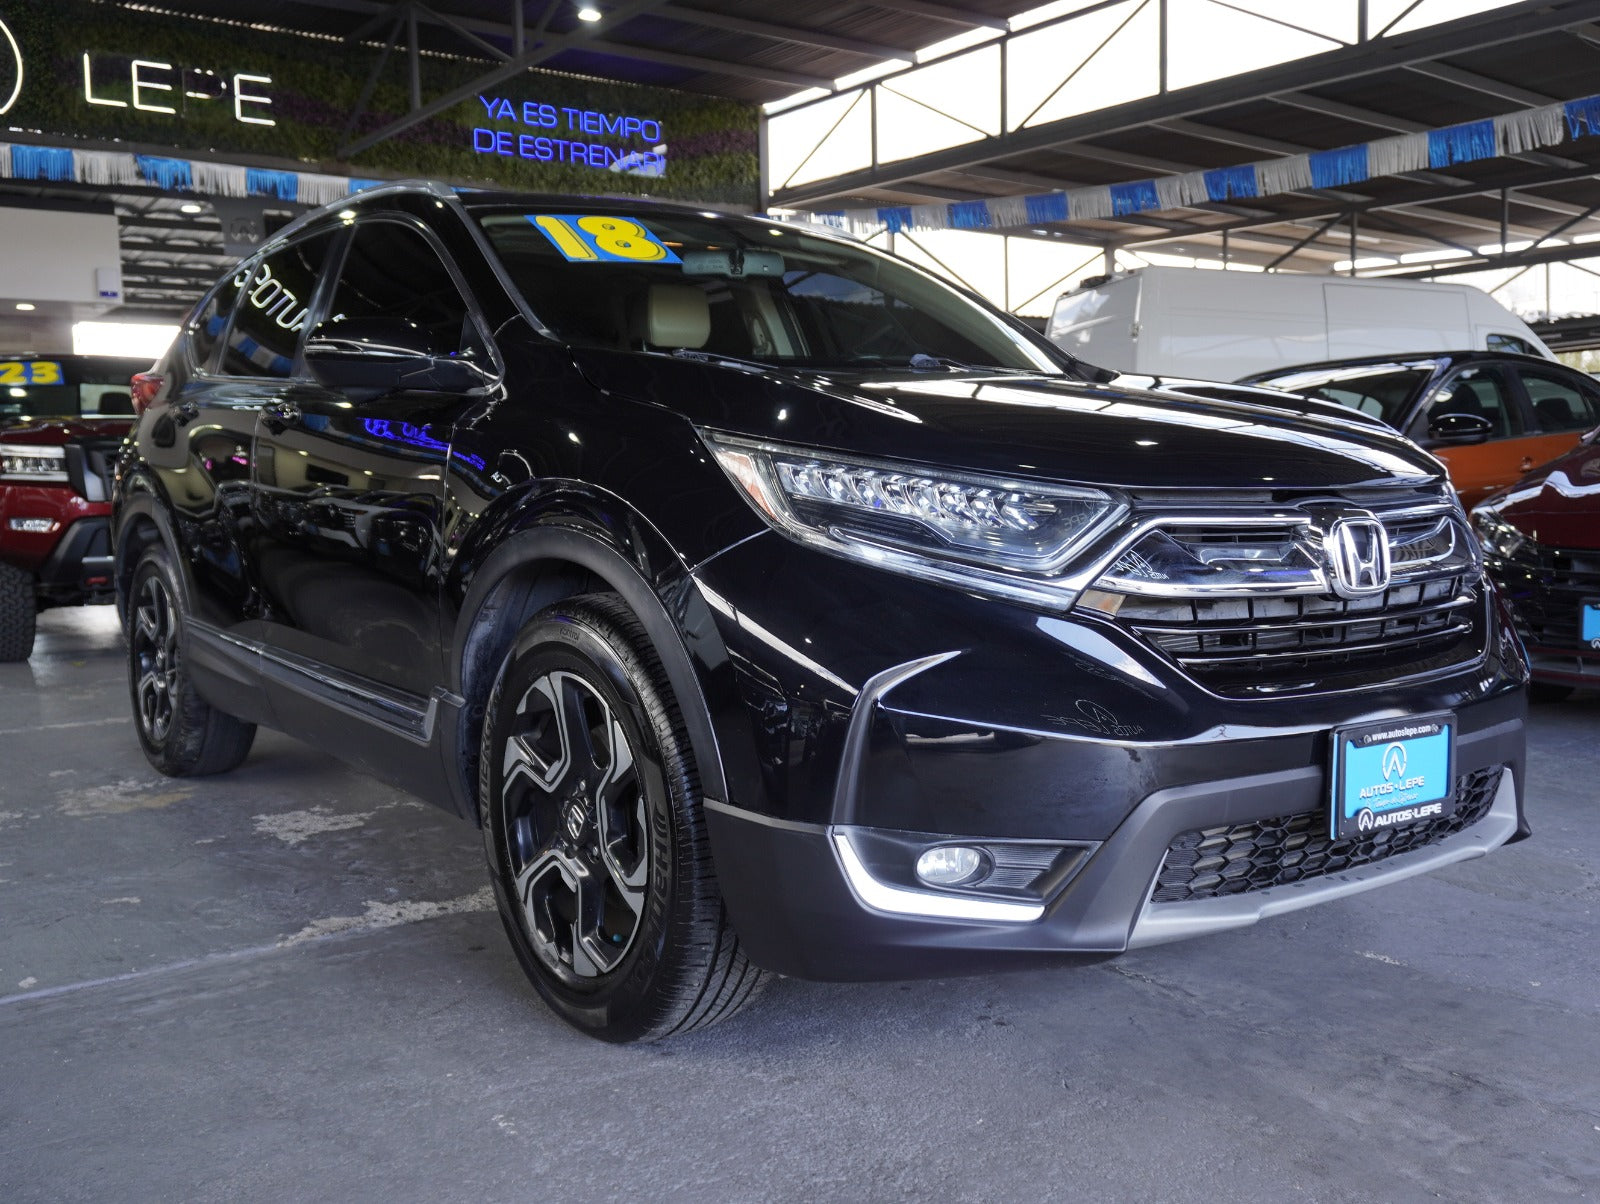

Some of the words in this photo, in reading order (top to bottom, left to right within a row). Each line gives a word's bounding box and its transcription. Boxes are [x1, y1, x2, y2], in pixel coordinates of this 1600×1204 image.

[83, 52, 276, 127] LEPE
[479, 95, 518, 122] YA
[523, 101, 558, 129] ES
[561, 107, 661, 144] TIEMPO
[473, 127, 515, 157] DE
[534, 215, 667, 261] 18
[0, 361, 60, 385] 23
[1371, 724, 1432, 742] www.autoslepe.com
